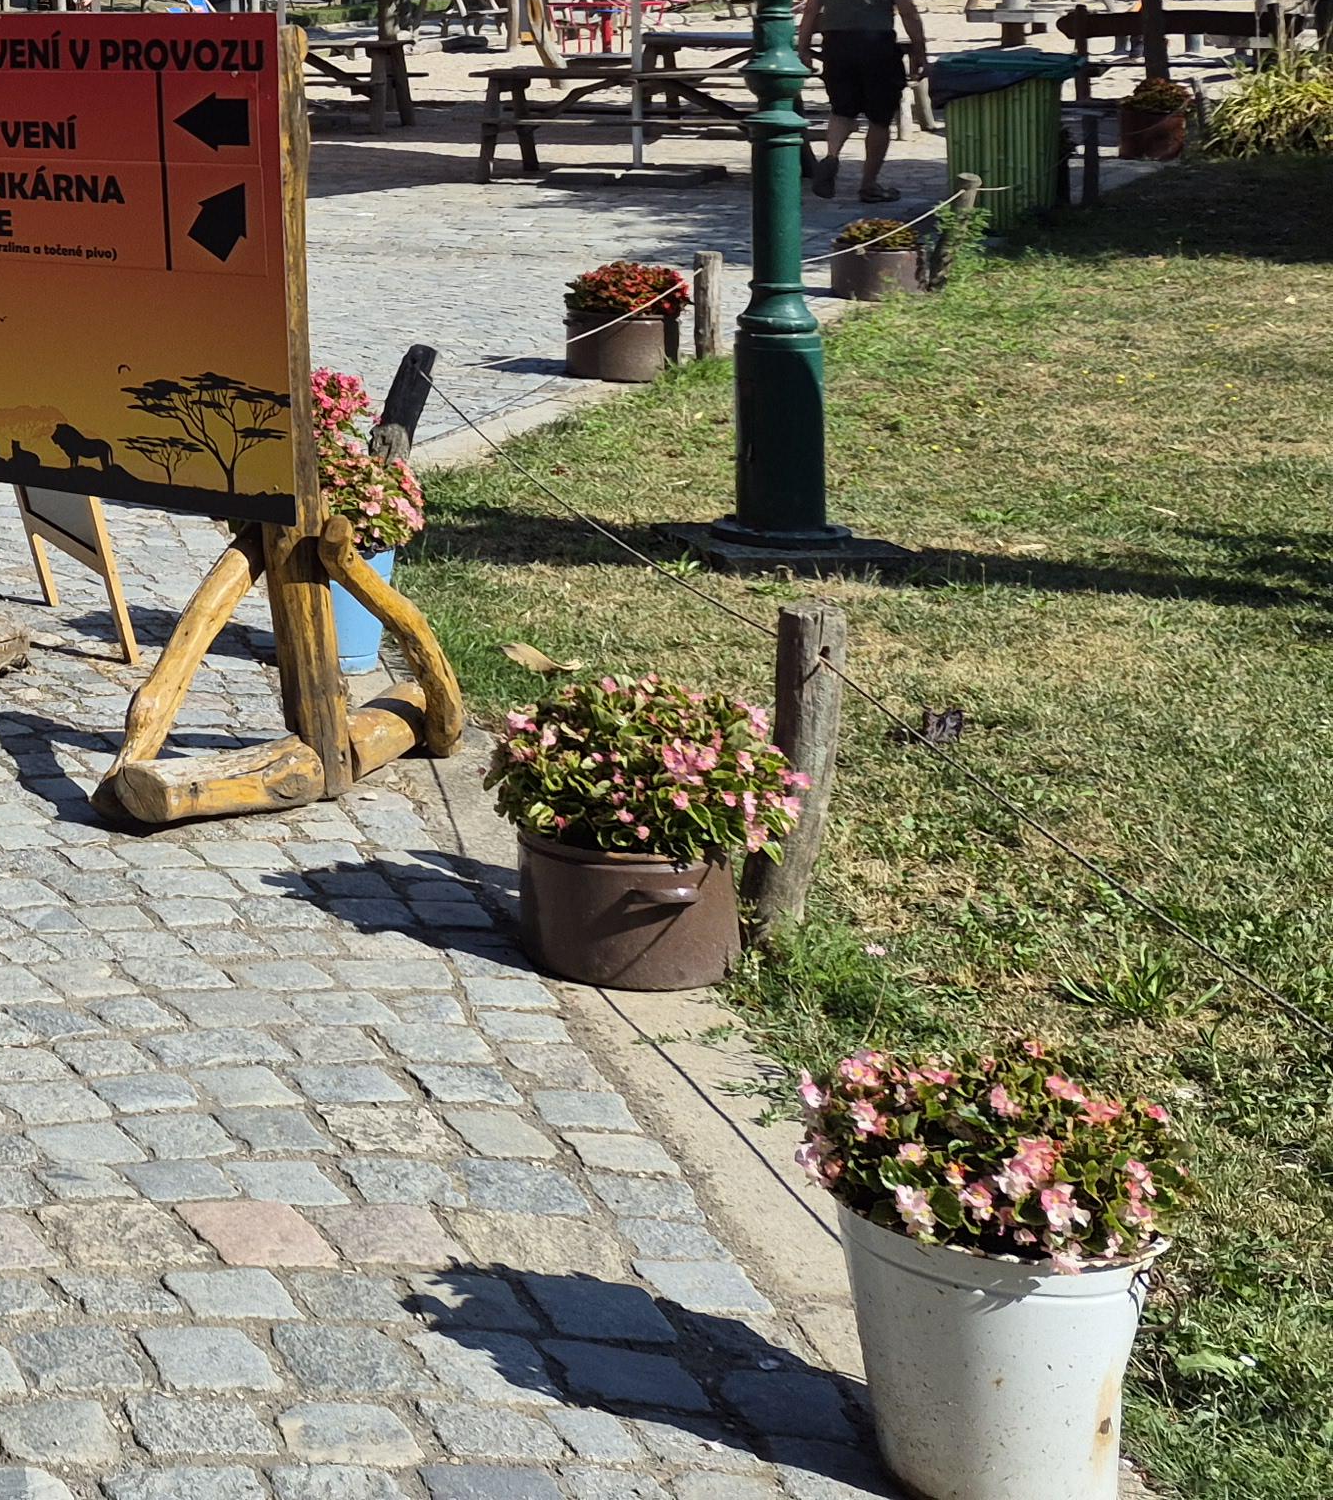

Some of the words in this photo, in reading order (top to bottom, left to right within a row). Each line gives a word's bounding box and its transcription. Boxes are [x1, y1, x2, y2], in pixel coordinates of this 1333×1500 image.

[68, 40, 91, 69] V
[100, 38, 265, 72] PROVOZU
[33, 245, 41, 256] a
[43, 243, 84, 259] točené
[86, 246, 118, 262] pivo)
